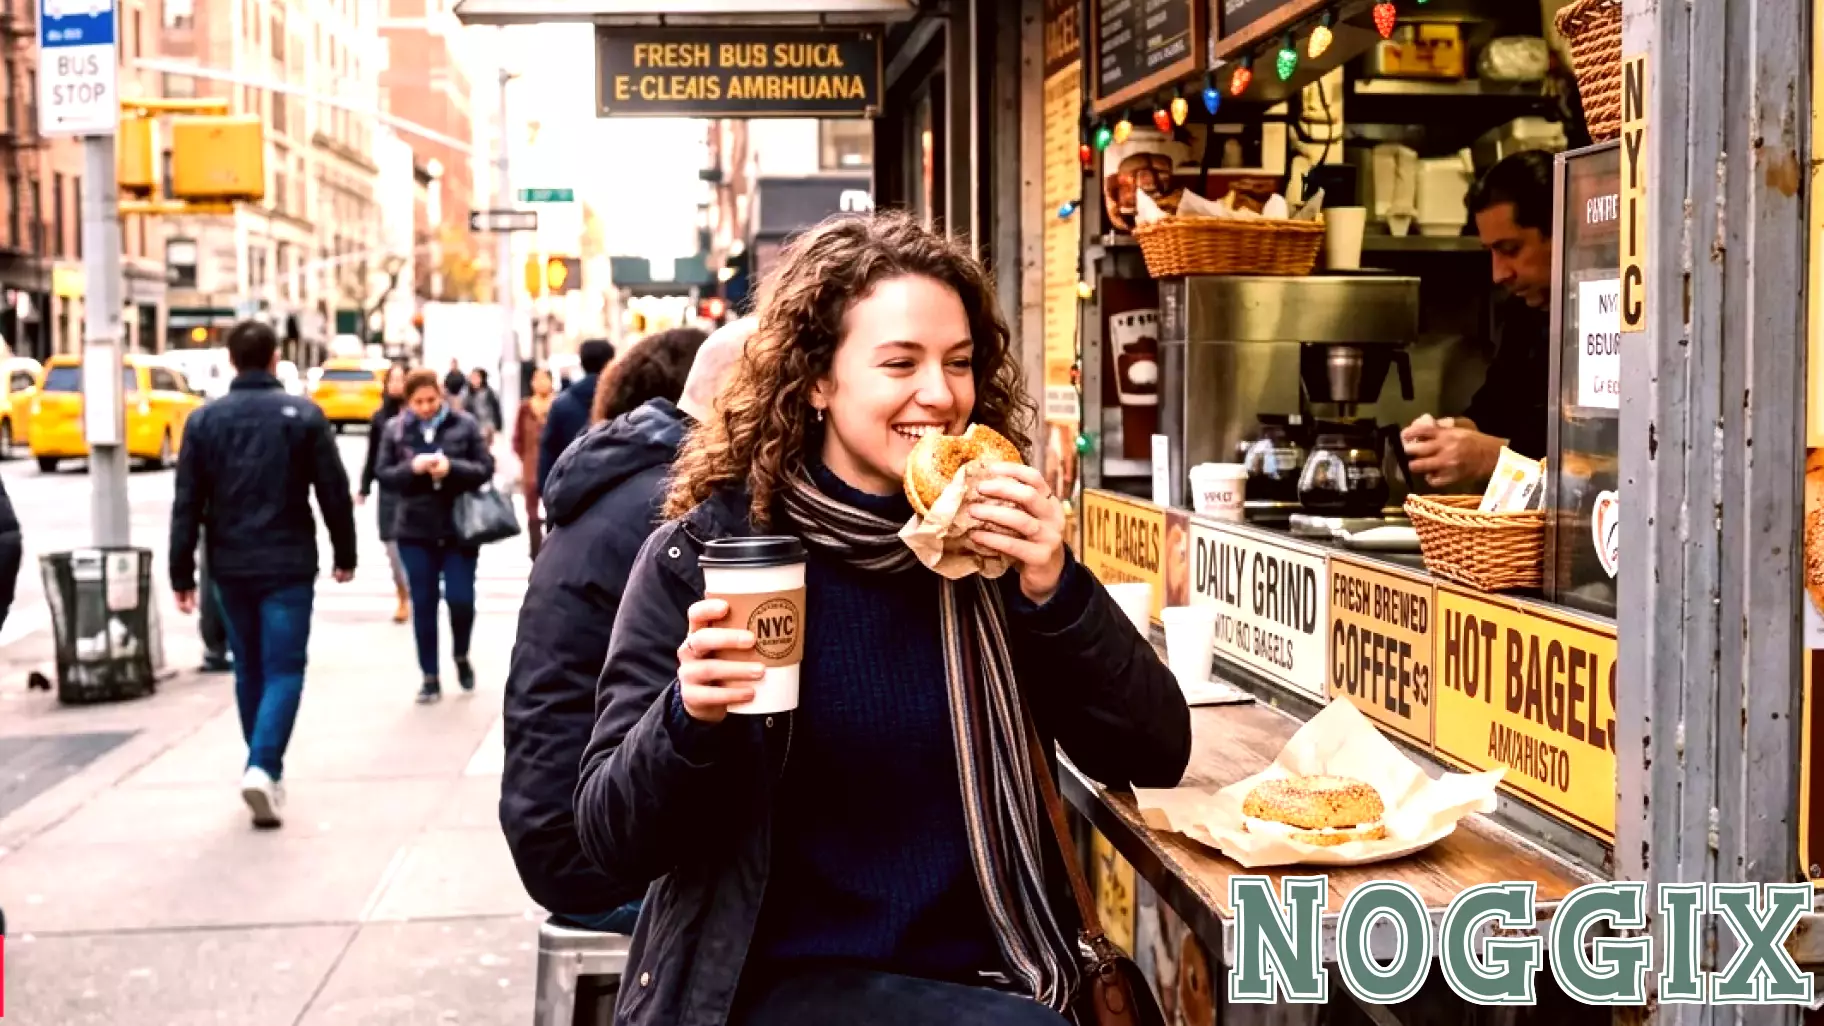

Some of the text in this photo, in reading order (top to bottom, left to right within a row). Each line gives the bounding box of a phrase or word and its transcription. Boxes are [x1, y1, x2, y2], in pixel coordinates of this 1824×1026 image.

[57, 54, 99, 76] BUS
[633, 43, 710, 67] FRESH
[53, 82, 106, 105] STOP
[1115, 512, 1160, 573] BAGELS
[1196, 536, 1316, 634] DAILY GRIND
[1333, 572, 1428, 634] FRESH BREWED
[757, 615, 794, 639] NYC
[1444, 609, 1497, 704] HOT
[1332, 618, 1429, 720] COFFEE $3
